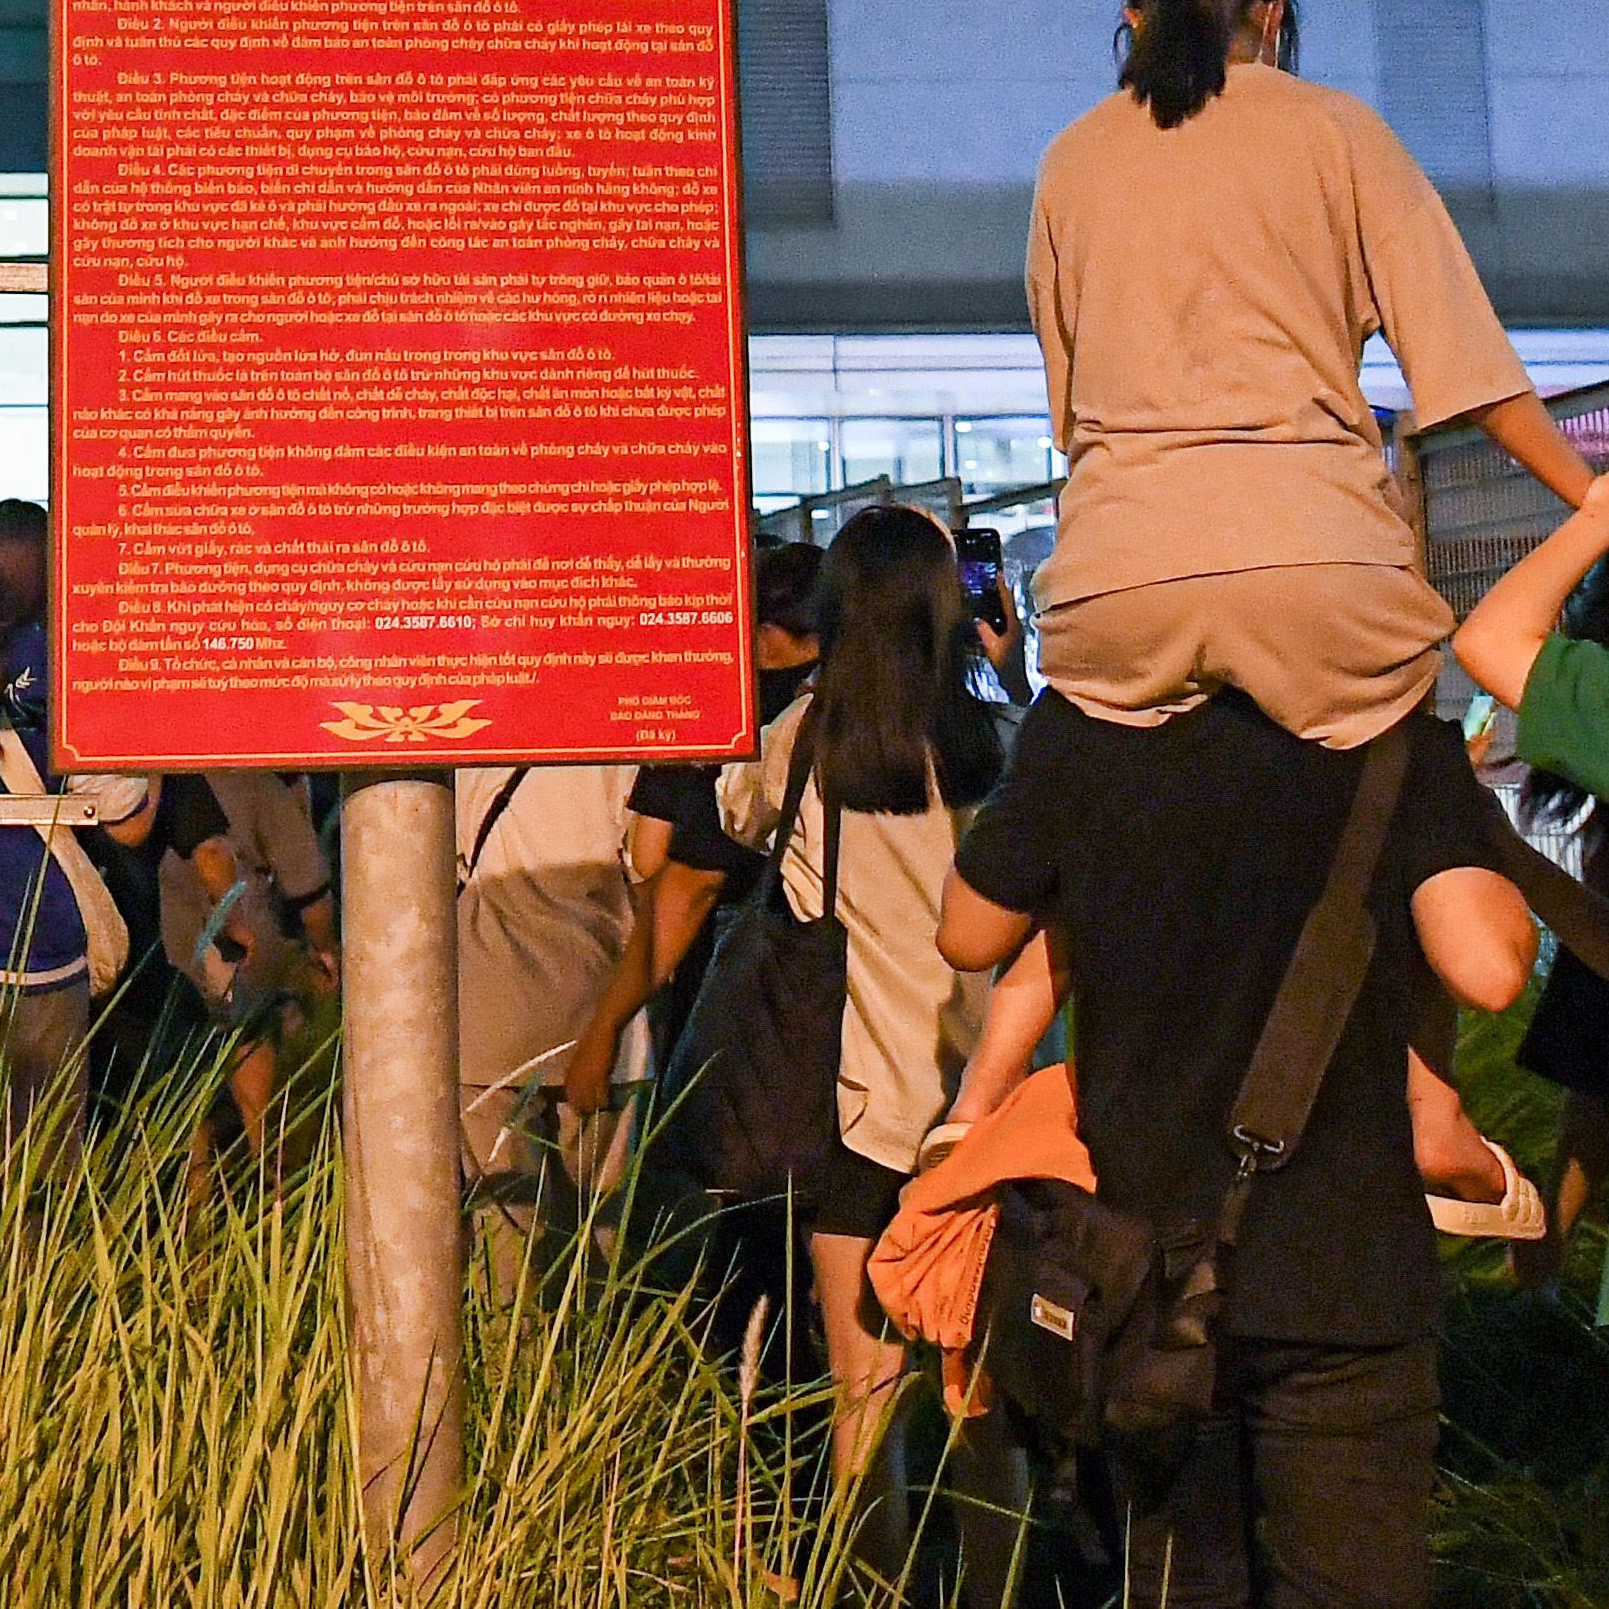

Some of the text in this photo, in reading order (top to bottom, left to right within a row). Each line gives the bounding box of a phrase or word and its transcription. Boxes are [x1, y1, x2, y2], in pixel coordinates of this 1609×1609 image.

[374, 615, 476, 631] 024.3587.6610;
[639, 611, 733, 626] 024.3587.6606
[202, 636, 254, 650] 146.750
